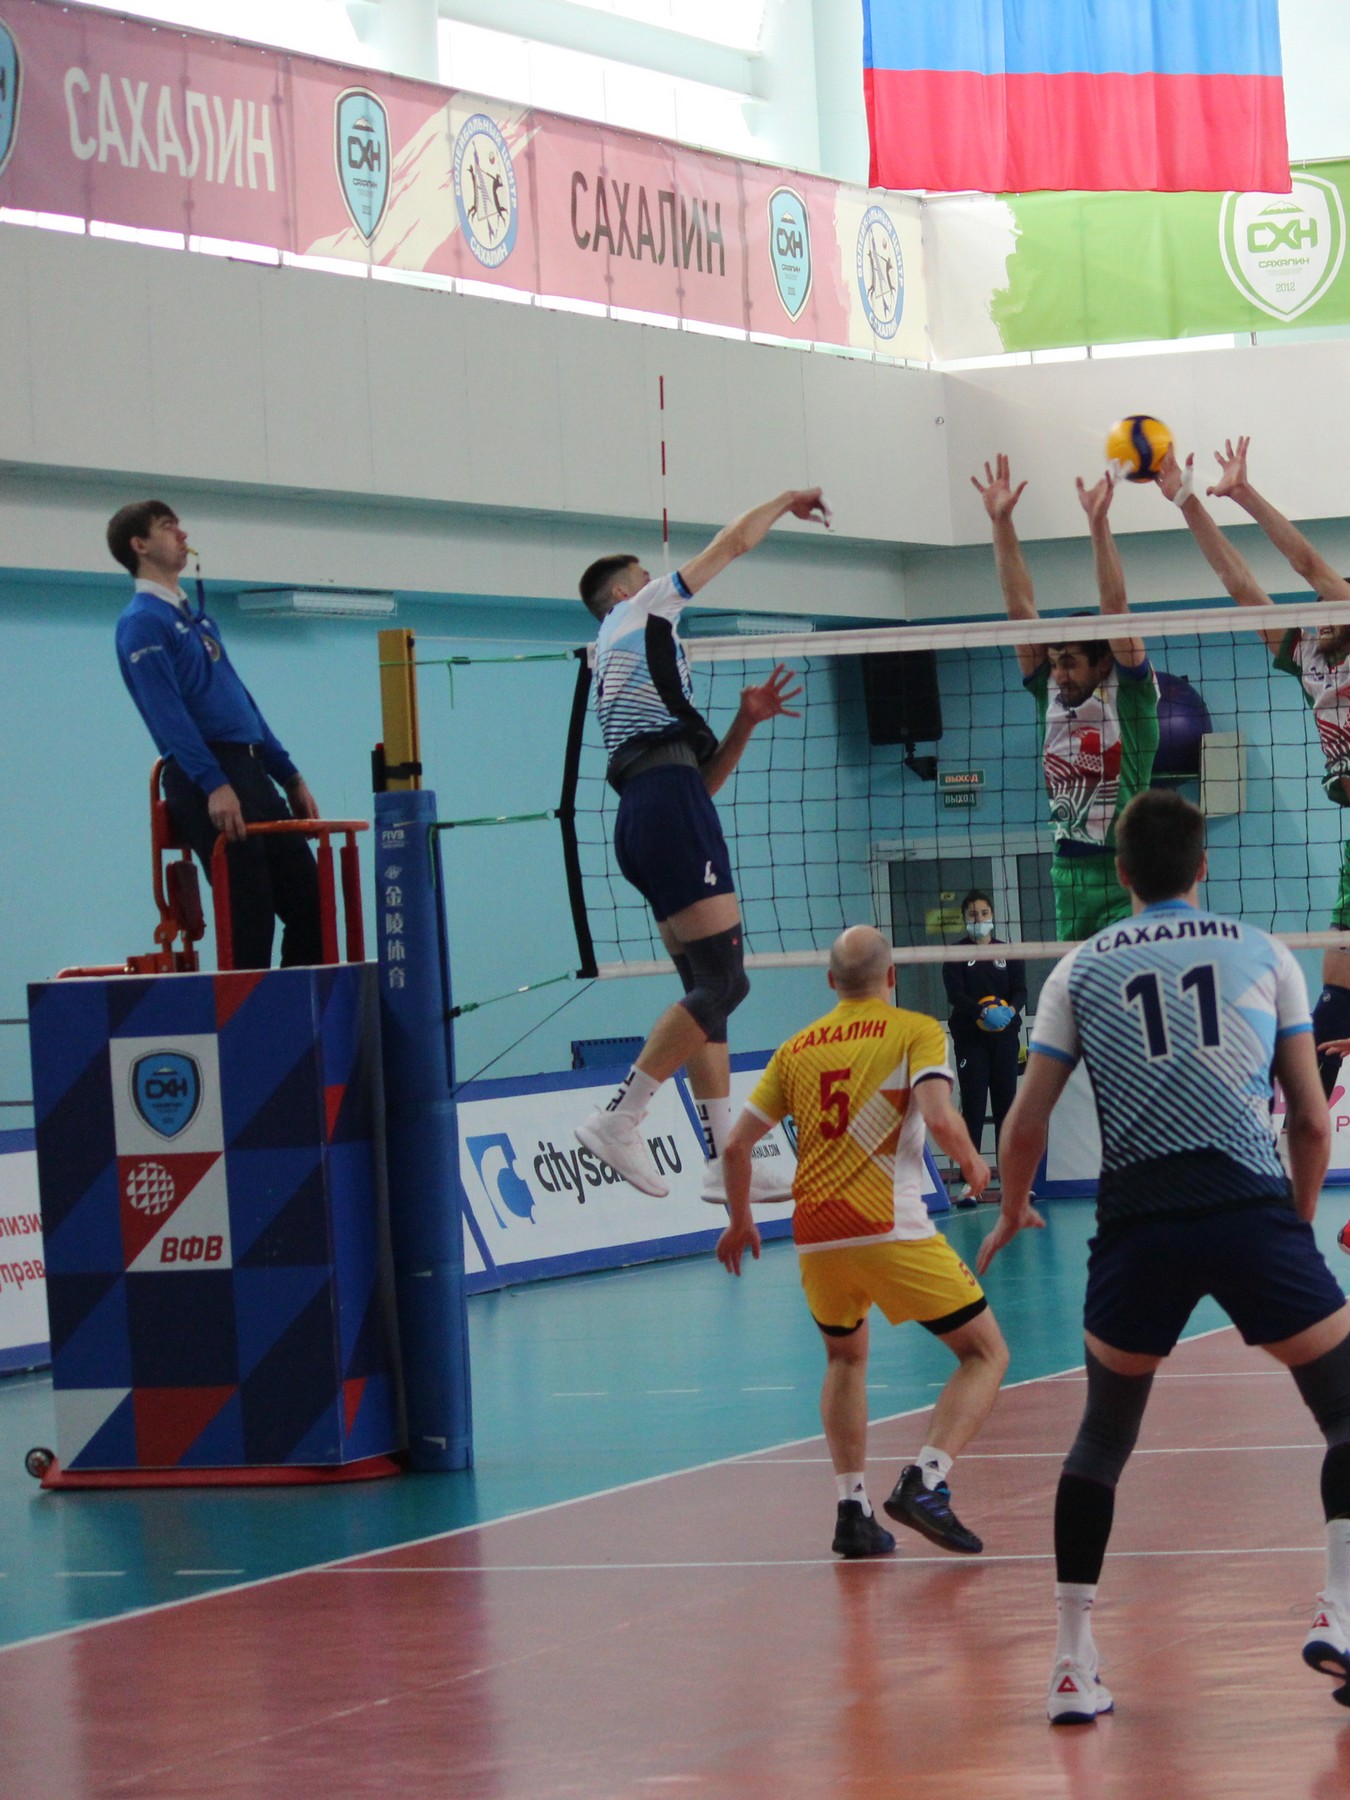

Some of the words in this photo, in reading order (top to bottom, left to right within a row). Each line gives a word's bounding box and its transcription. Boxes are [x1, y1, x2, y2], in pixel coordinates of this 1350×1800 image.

[63, 66, 276, 192] САХАЛИН
[570, 171, 726, 277] САХАЛИН
[470, 237, 508, 266] САХАЛИН
[1275, 282, 1296, 293] 2012
[704, 860, 717, 886] 4
[1096, 921, 1239, 953] САХАЛИН
[1124, 964, 1221, 1058] 11
[793, 1020, 887, 1054] САХАЛИН
[818, 1067, 851, 1140] 5
[159, 1235, 224, 1263] ВФВ
